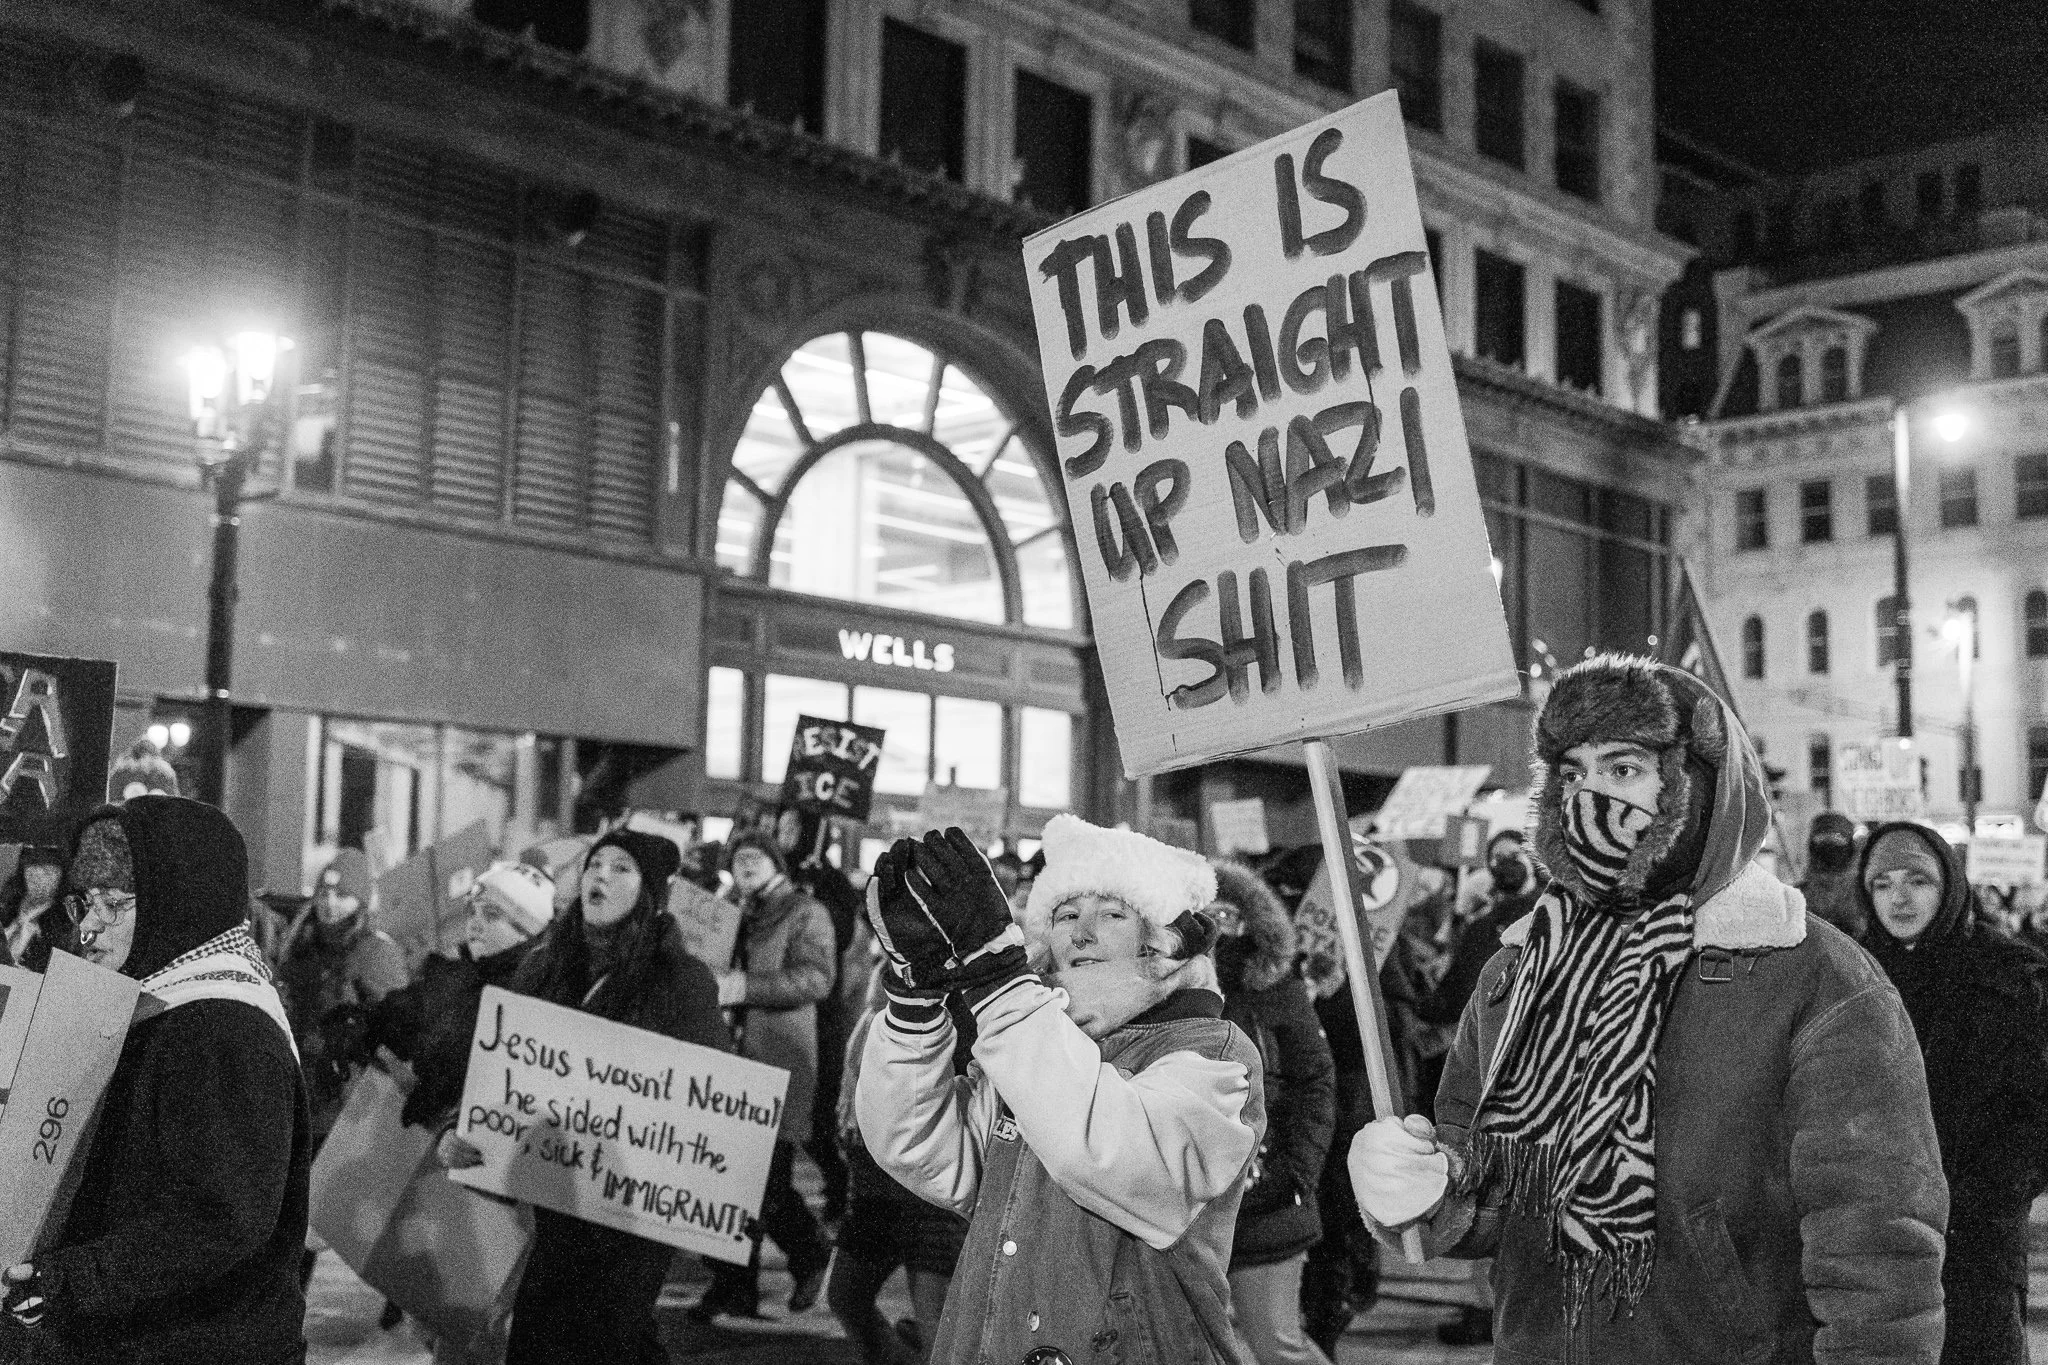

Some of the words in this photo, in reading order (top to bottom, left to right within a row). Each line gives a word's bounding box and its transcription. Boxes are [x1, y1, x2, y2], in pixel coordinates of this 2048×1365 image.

[1039, 190, 1232, 361] THIS
[1274, 128, 1368, 262] IS
[1056, 250, 1428, 480] STRAIGHT
[1090, 458, 1191, 583] UP
[1225, 386, 1436, 544] NAZI
[838, 629, 955, 673] WELLS
[1156, 544, 1408, 708] SHIT
[794, 771, 860, 808] ICE
[479, 1004, 571, 1077] Jesus
[687, 1074, 782, 1128] Neutral
[504, 1067, 537, 1115] he
[548, 1098, 622, 1141] sided
[628, 1122, 684, 1164] with
[688, 1133, 727, 1174] the
[32, 1096, 69, 1165] 296
[540, 1140, 583, 1171] sick
